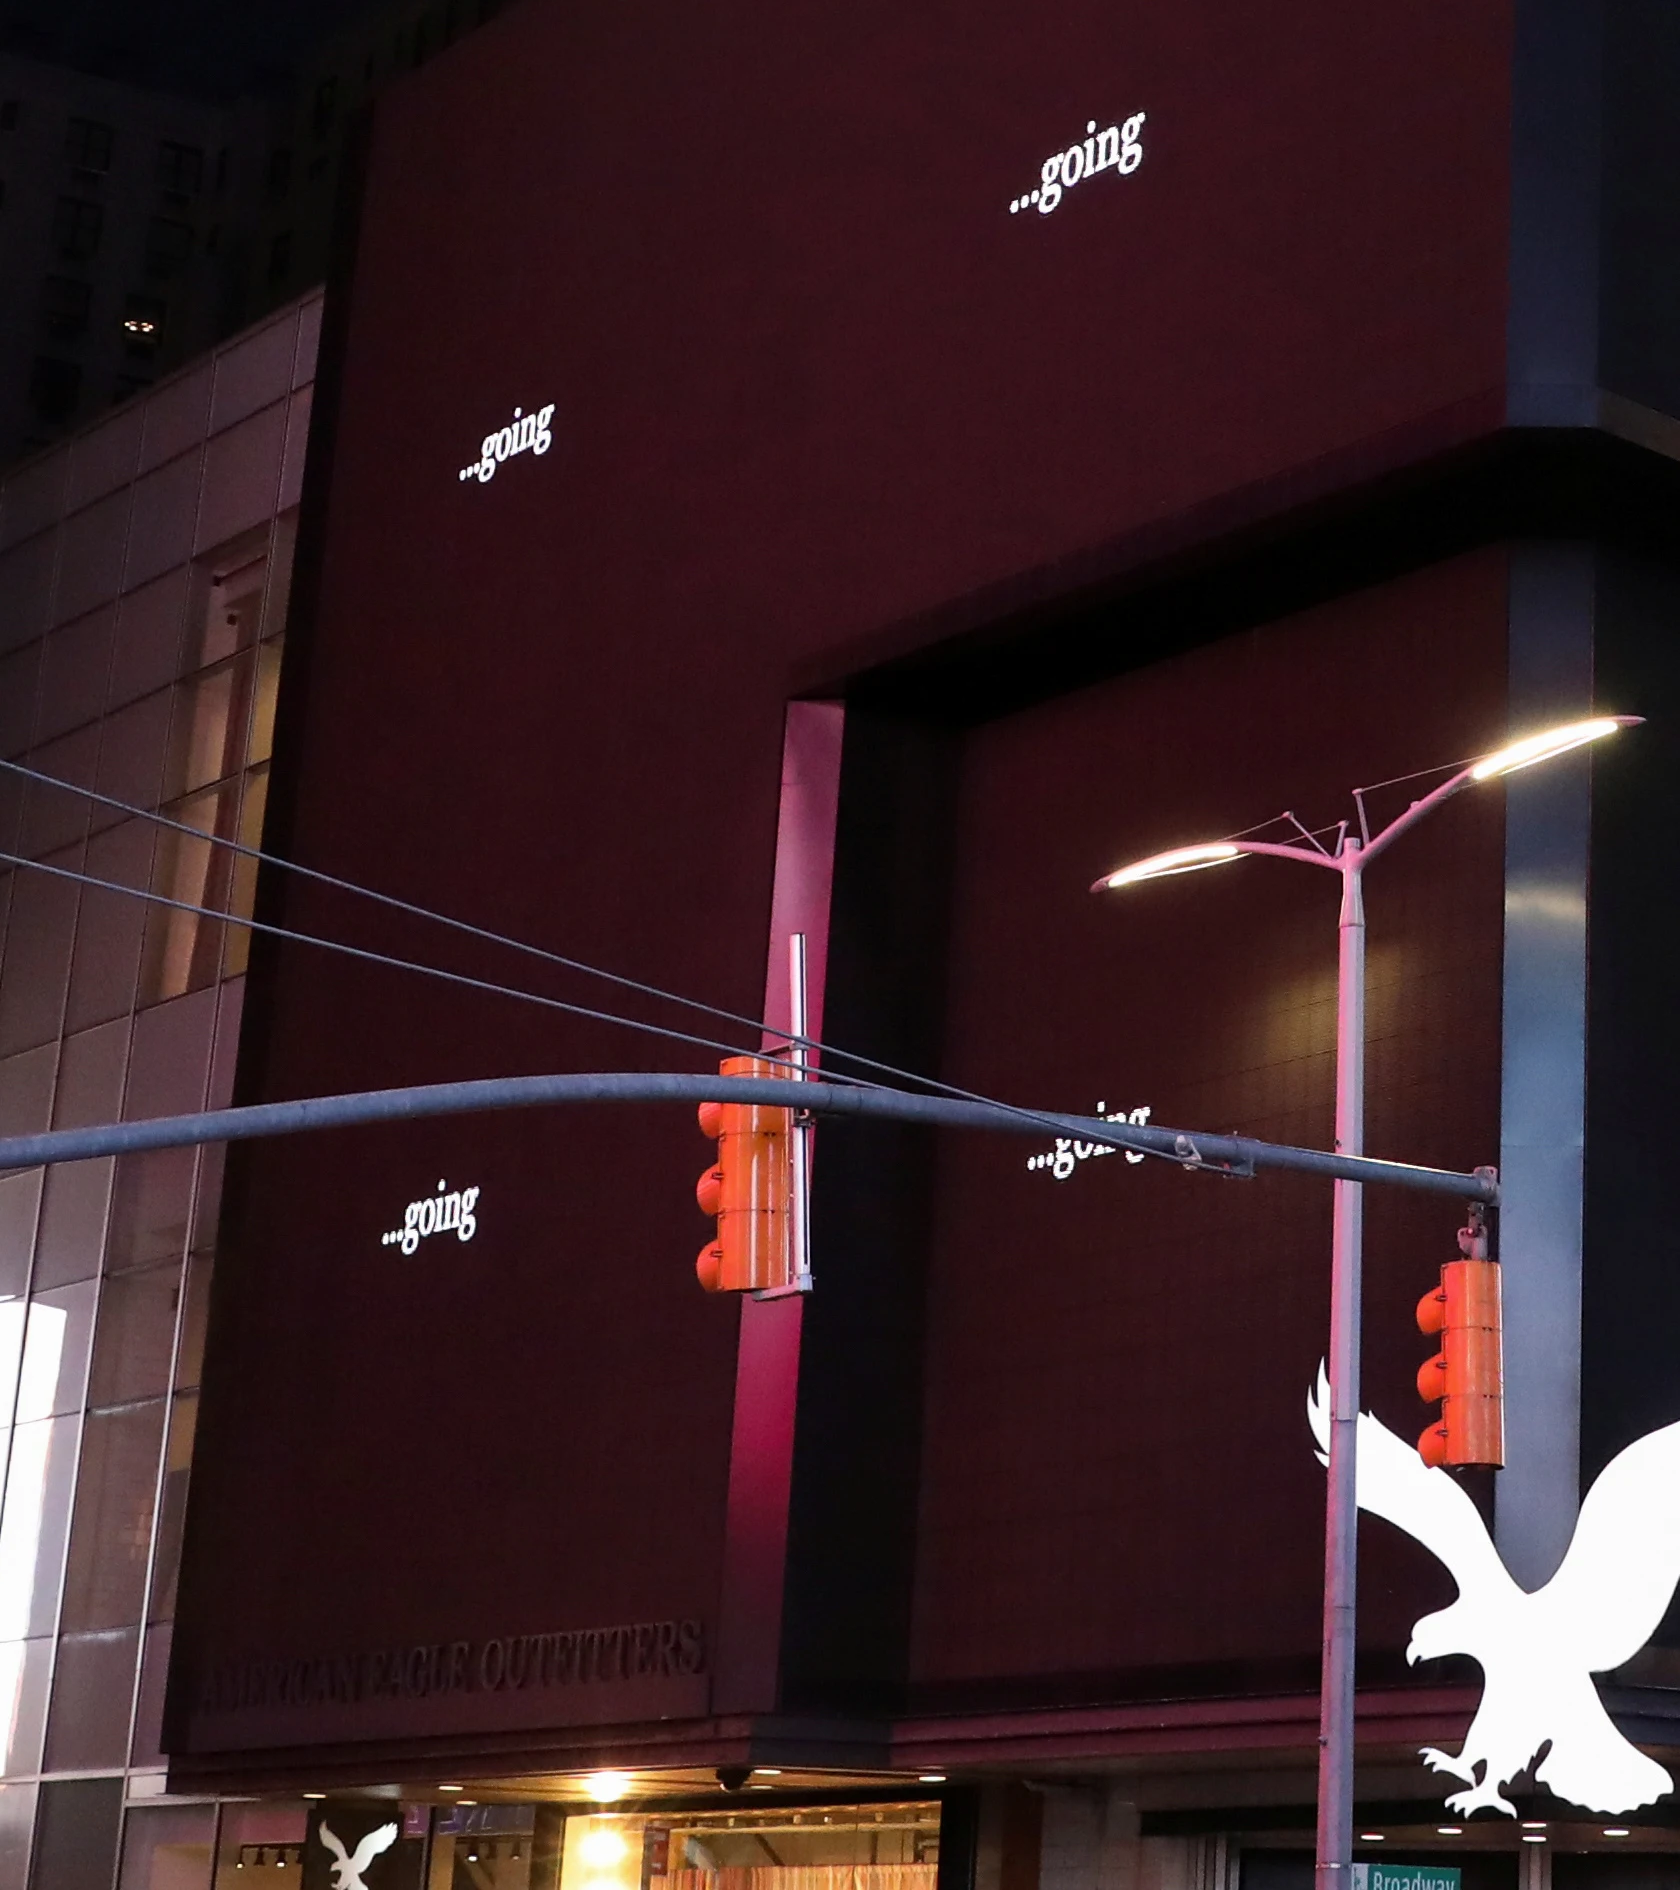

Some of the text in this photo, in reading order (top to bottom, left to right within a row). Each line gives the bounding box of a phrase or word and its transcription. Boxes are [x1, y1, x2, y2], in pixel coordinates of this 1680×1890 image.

[1009, 111, 1146, 215] ...going
[458, 403, 555, 483] ...going
[381, 1178, 480, 1255] ...going
[201, 1619, 705, 1710] AMERICAN EAGLE OUTFITTERS
